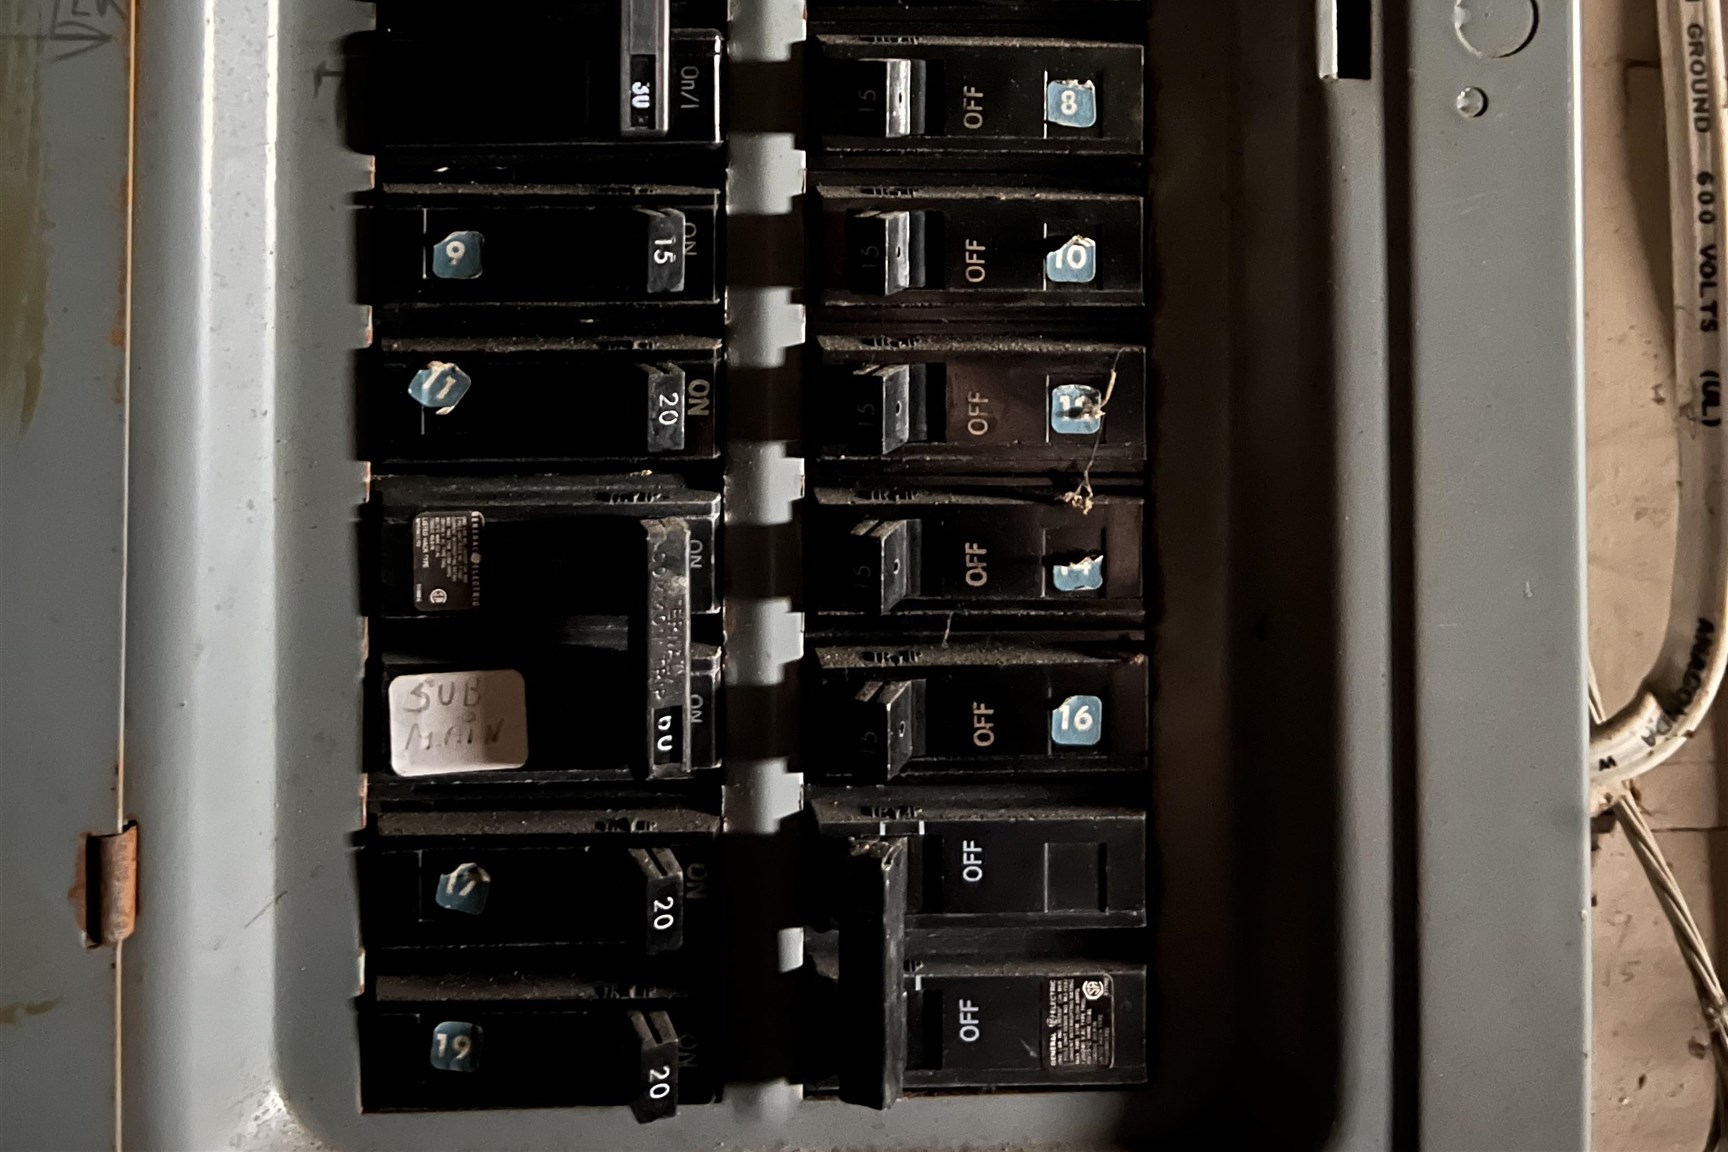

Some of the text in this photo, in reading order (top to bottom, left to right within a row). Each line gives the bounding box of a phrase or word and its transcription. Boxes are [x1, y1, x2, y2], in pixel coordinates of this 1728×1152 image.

[1688, 22, 1711, 133] GROUND
[963, 85, 985, 130] OFF
[1060, 89, 1078, 116] 8
[1697, 172, 1716, 224] 600
[445, 240, 466, 265] 9
[653, 238, 677, 265] 15
[685, 221, 698, 256] ON
[965, 238, 987, 284] OFF
[1054, 244, 1087, 270] 10
[1699, 244, 1719, 332] VOLTS
[658, 392, 680, 426] 20
[687, 378, 711, 417] ON
[967, 391, 989, 436] OFF
[690, 539, 703, 569] ON
[965, 541, 988, 587] OFF
[403, 677, 481, 714] SUB
[690, 693, 703, 724] ON
[972, 700, 995, 748] OFF
[1059, 703, 1094, 730] 16
[962, 839, 984, 883] OFF
[687, 863, 709, 899] ON
[653, 896, 674, 931] 20
[958, 998, 980, 1042] OFF
[1049, 979, 1057, 1066] GENERAL ELECTRIC
[435, 1033, 472, 1060] 19
[678, 1034, 698, 1068] ON
[649, 1065, 671, 1100] 20
